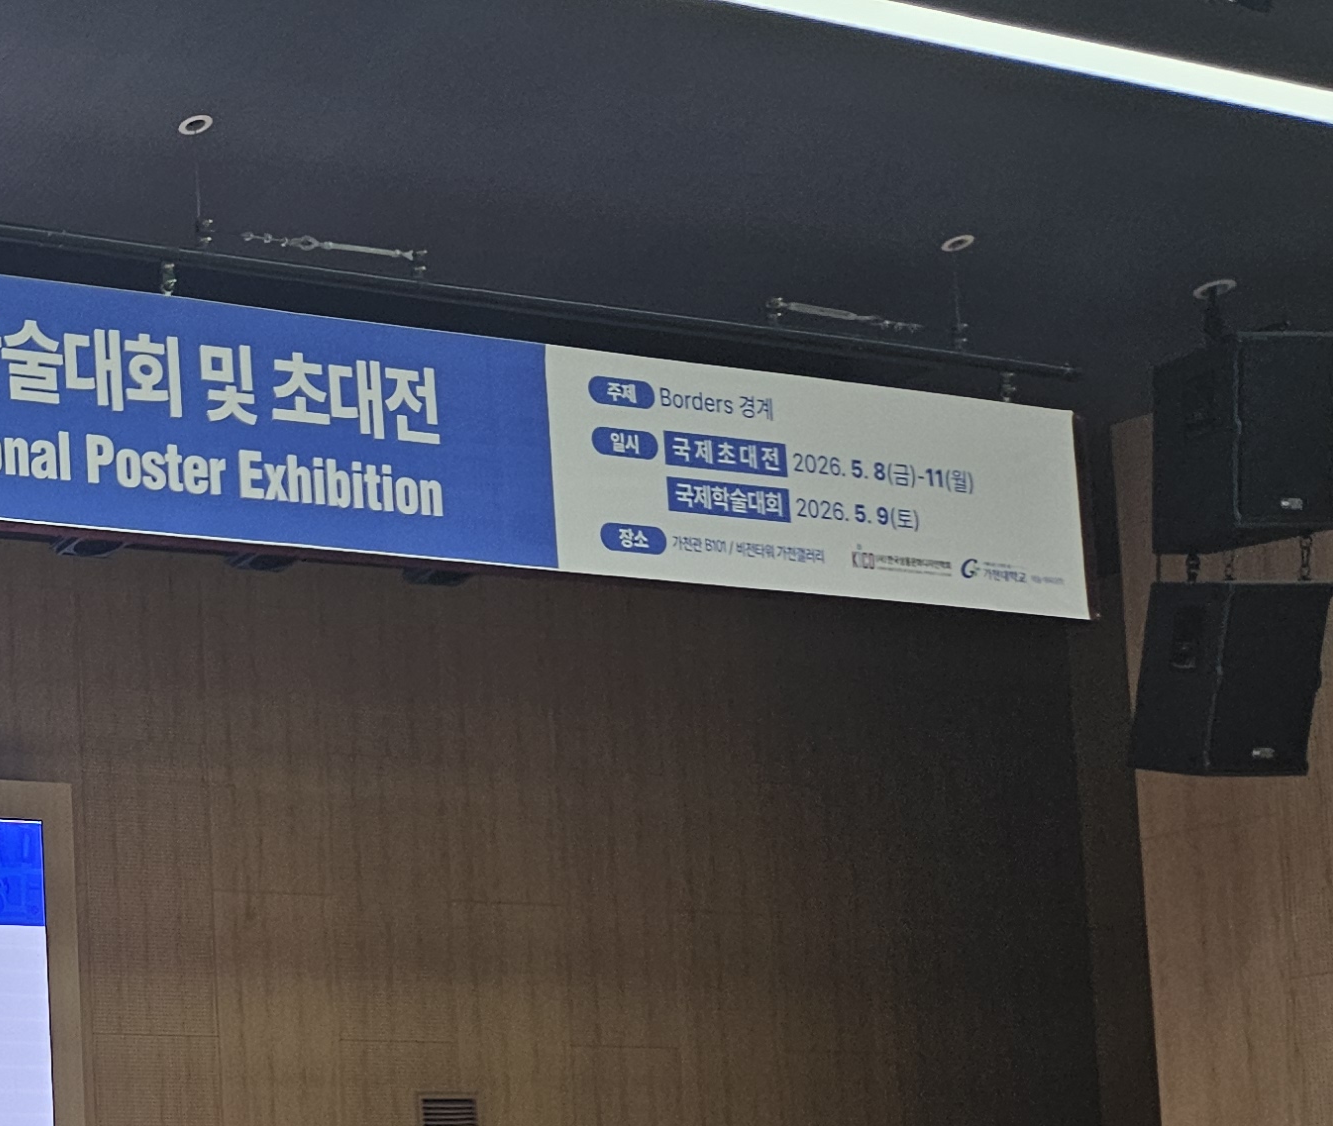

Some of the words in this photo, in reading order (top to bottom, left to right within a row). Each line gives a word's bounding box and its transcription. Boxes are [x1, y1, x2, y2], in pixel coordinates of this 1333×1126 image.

[200, 343, 259, 426] 및
[272, 352, 441, 444] 초대전
[607, 382, 637, 404] 주제
[659, 387, 734, 415] Borders
[739, 395, 774, 421] 경계
[610, 432, 640, 454] 일시
[86, 433, 226, 496] Poster
[239, 449, 444, 517] Exhibition
[793, 453, 846, 477] 2026.
[675, 483, 784, 516] 국제학술대회
[796, 498, 849, 522] 2026.
[618, 528, 649, 549] 장소
